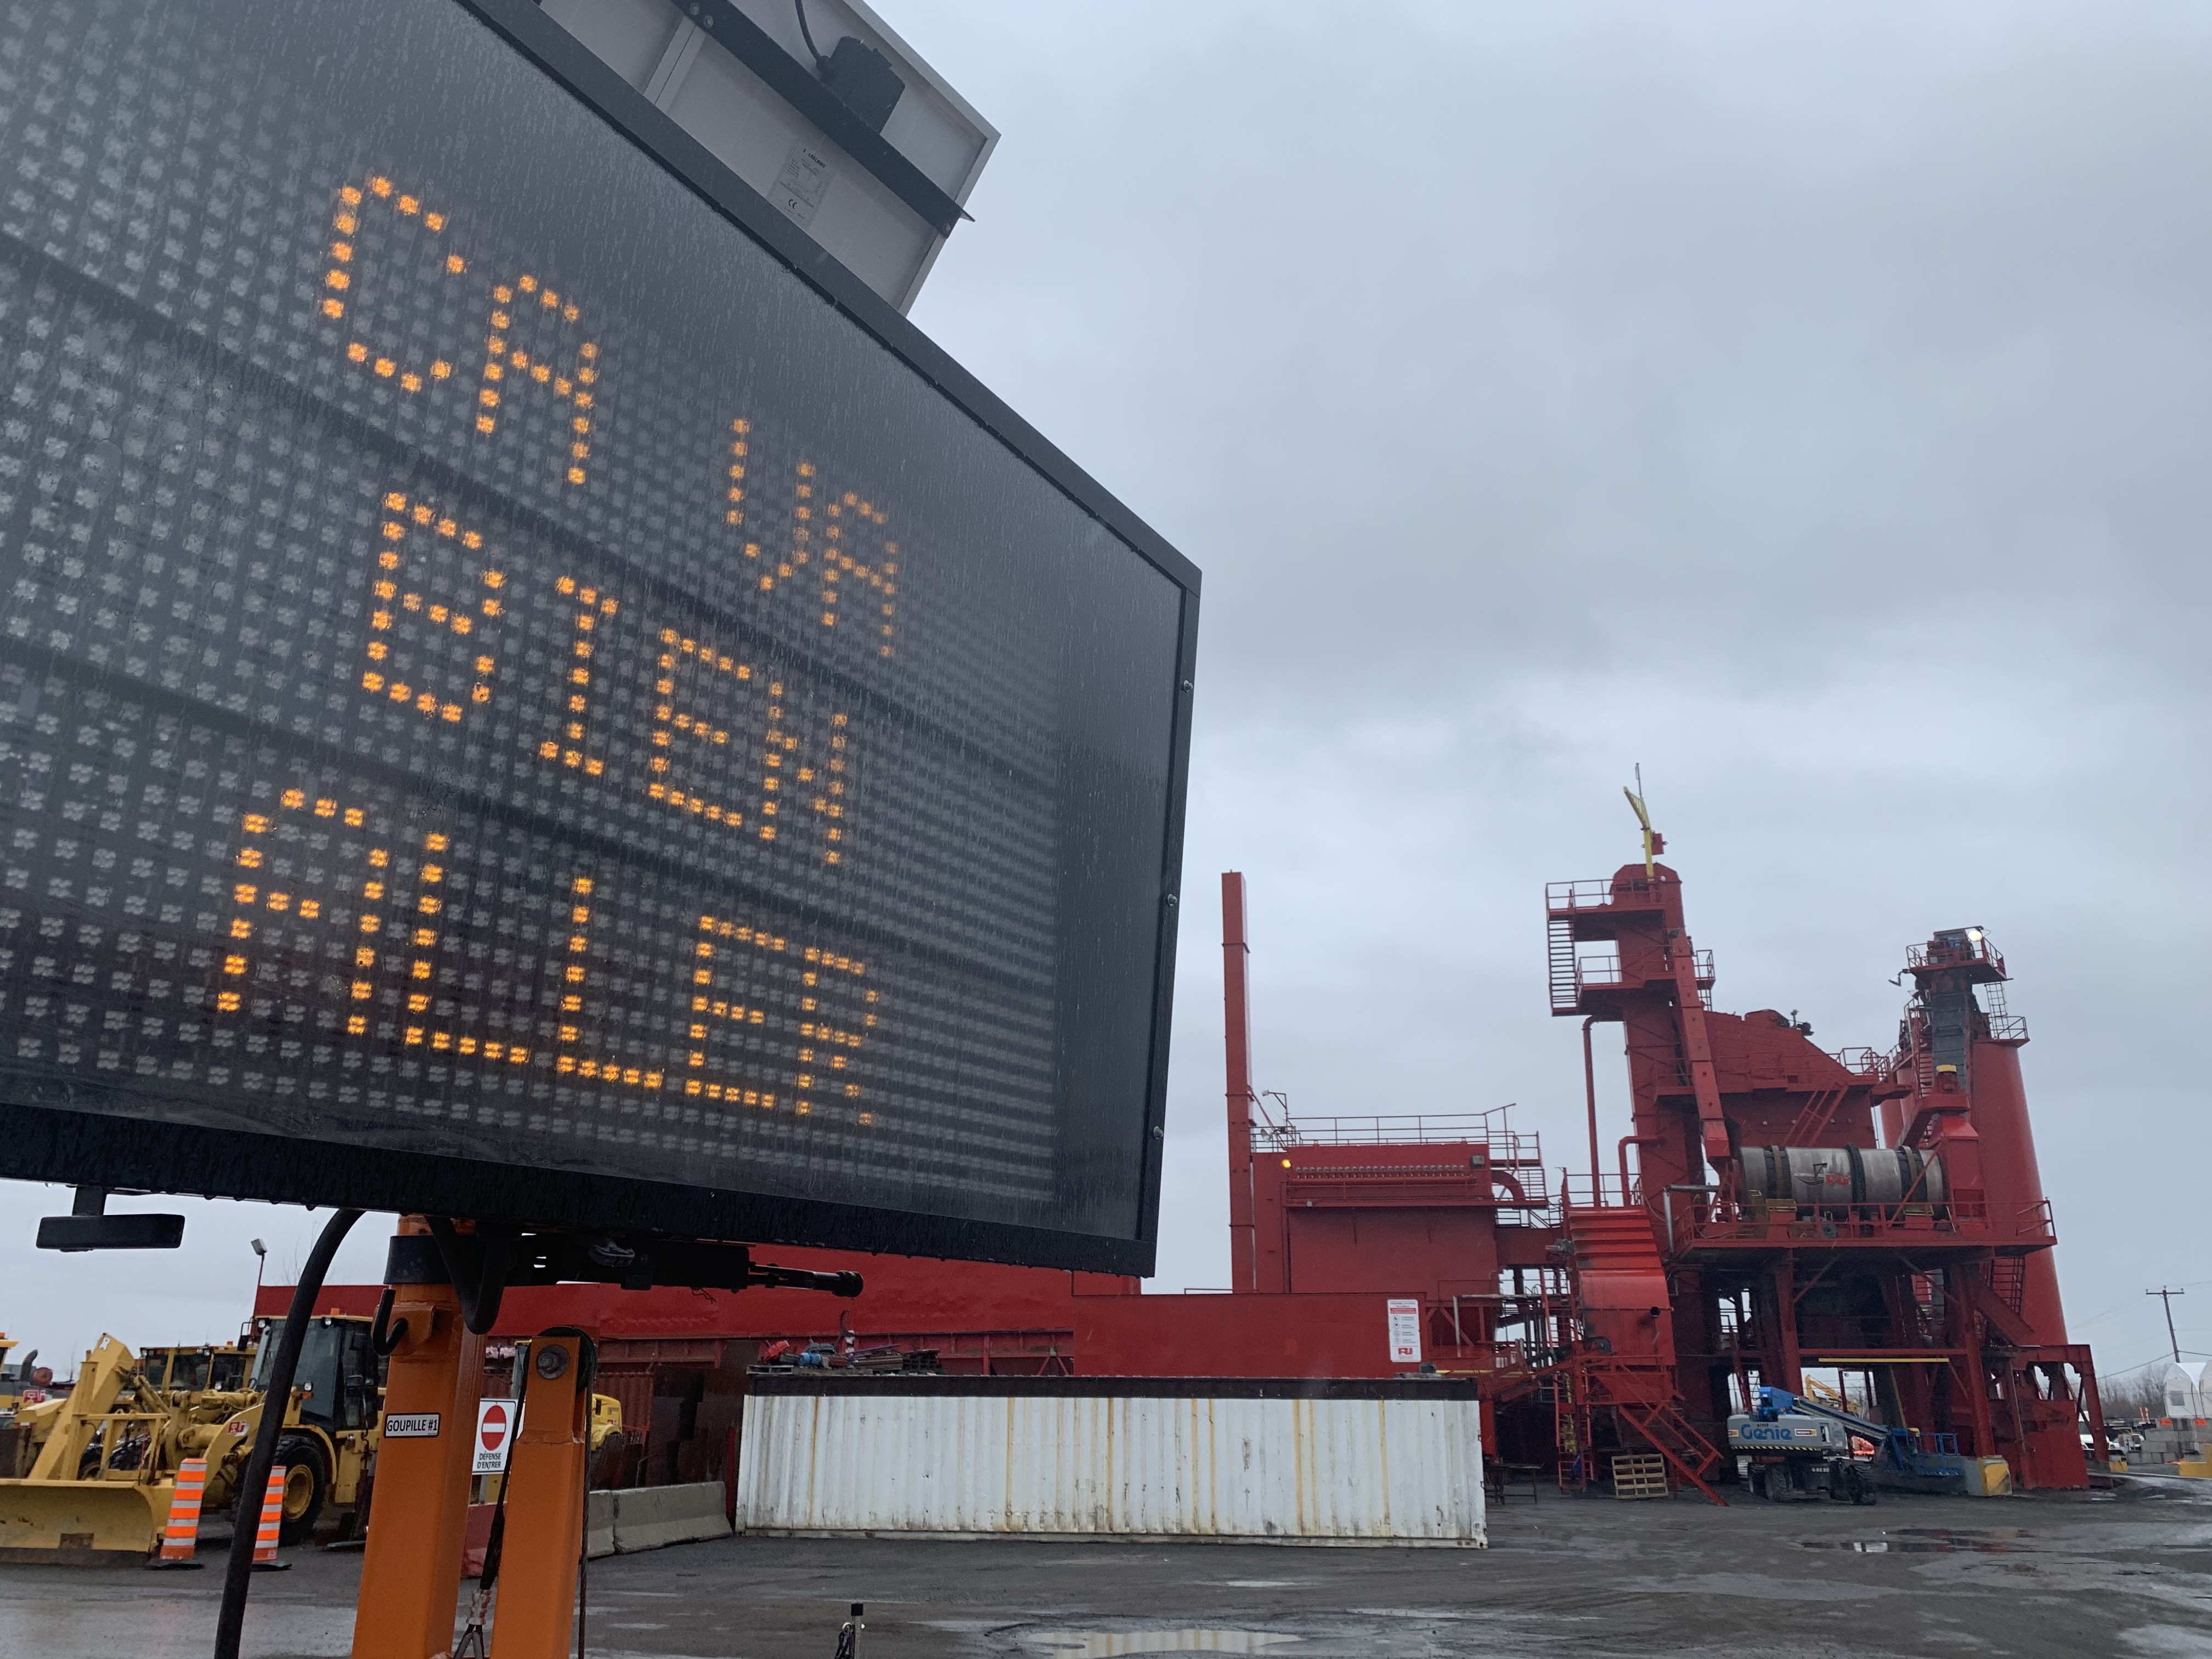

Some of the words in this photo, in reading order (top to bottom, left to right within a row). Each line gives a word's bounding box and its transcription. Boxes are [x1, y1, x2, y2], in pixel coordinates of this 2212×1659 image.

[323, 176, 598, 486] CA
[726, 418, 898, 657] VA
[361, 491, 847, 865] BIEN
[217, 788, 878, 1126] ALLER
[387, 1419, 427, 1432] GOUPILLE
[428, 1419, 438, 1431] #1
[1741, 1424, 1792, 1440] Genie
[479, 1450, 501, 1460] DÉFENSE
[477, 1461, 501, 1469] D'ENTRER
